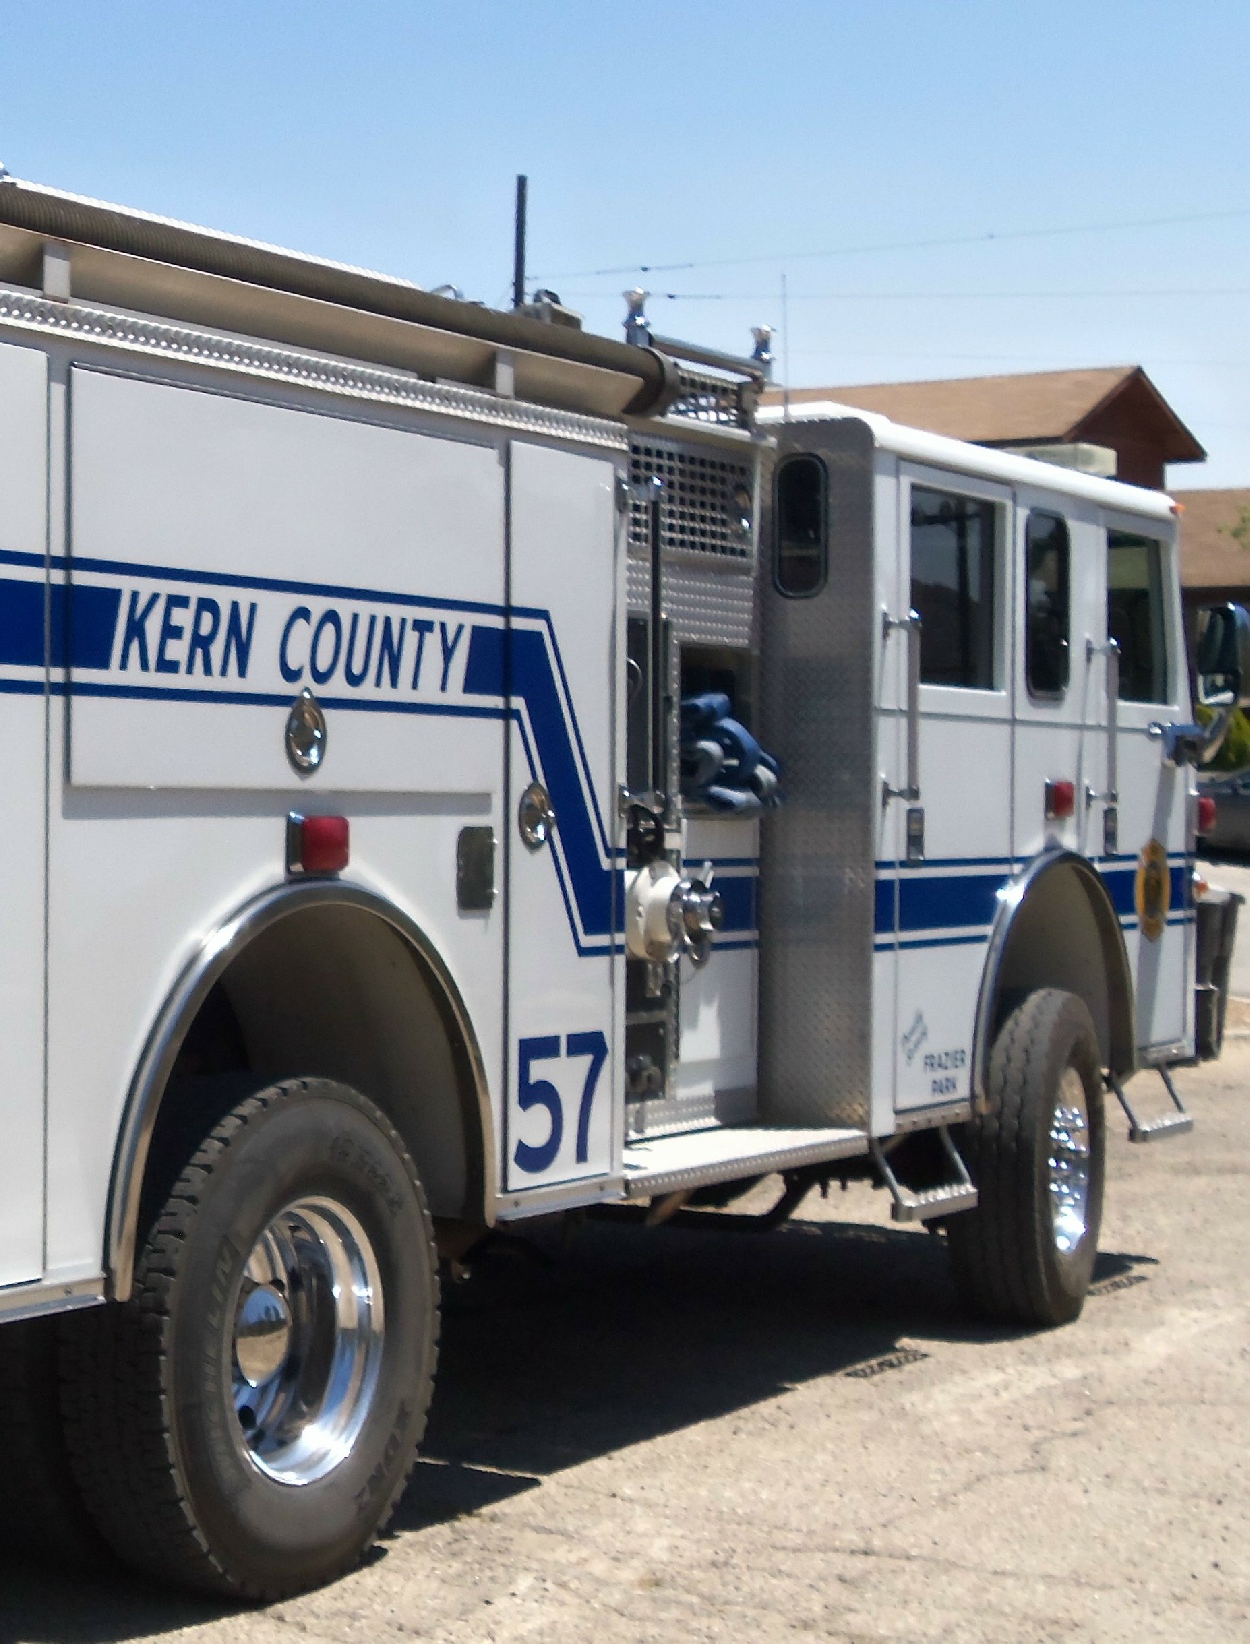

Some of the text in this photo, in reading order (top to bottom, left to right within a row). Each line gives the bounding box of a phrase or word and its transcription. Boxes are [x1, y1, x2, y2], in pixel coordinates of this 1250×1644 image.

[119, 590, 465, 693] KERN COUNTY
[923, 1049, 966, 1073] FRAZIER
[931, 1076, 957, 1095] PARK
[514, 1030, 609, 1174] 57
